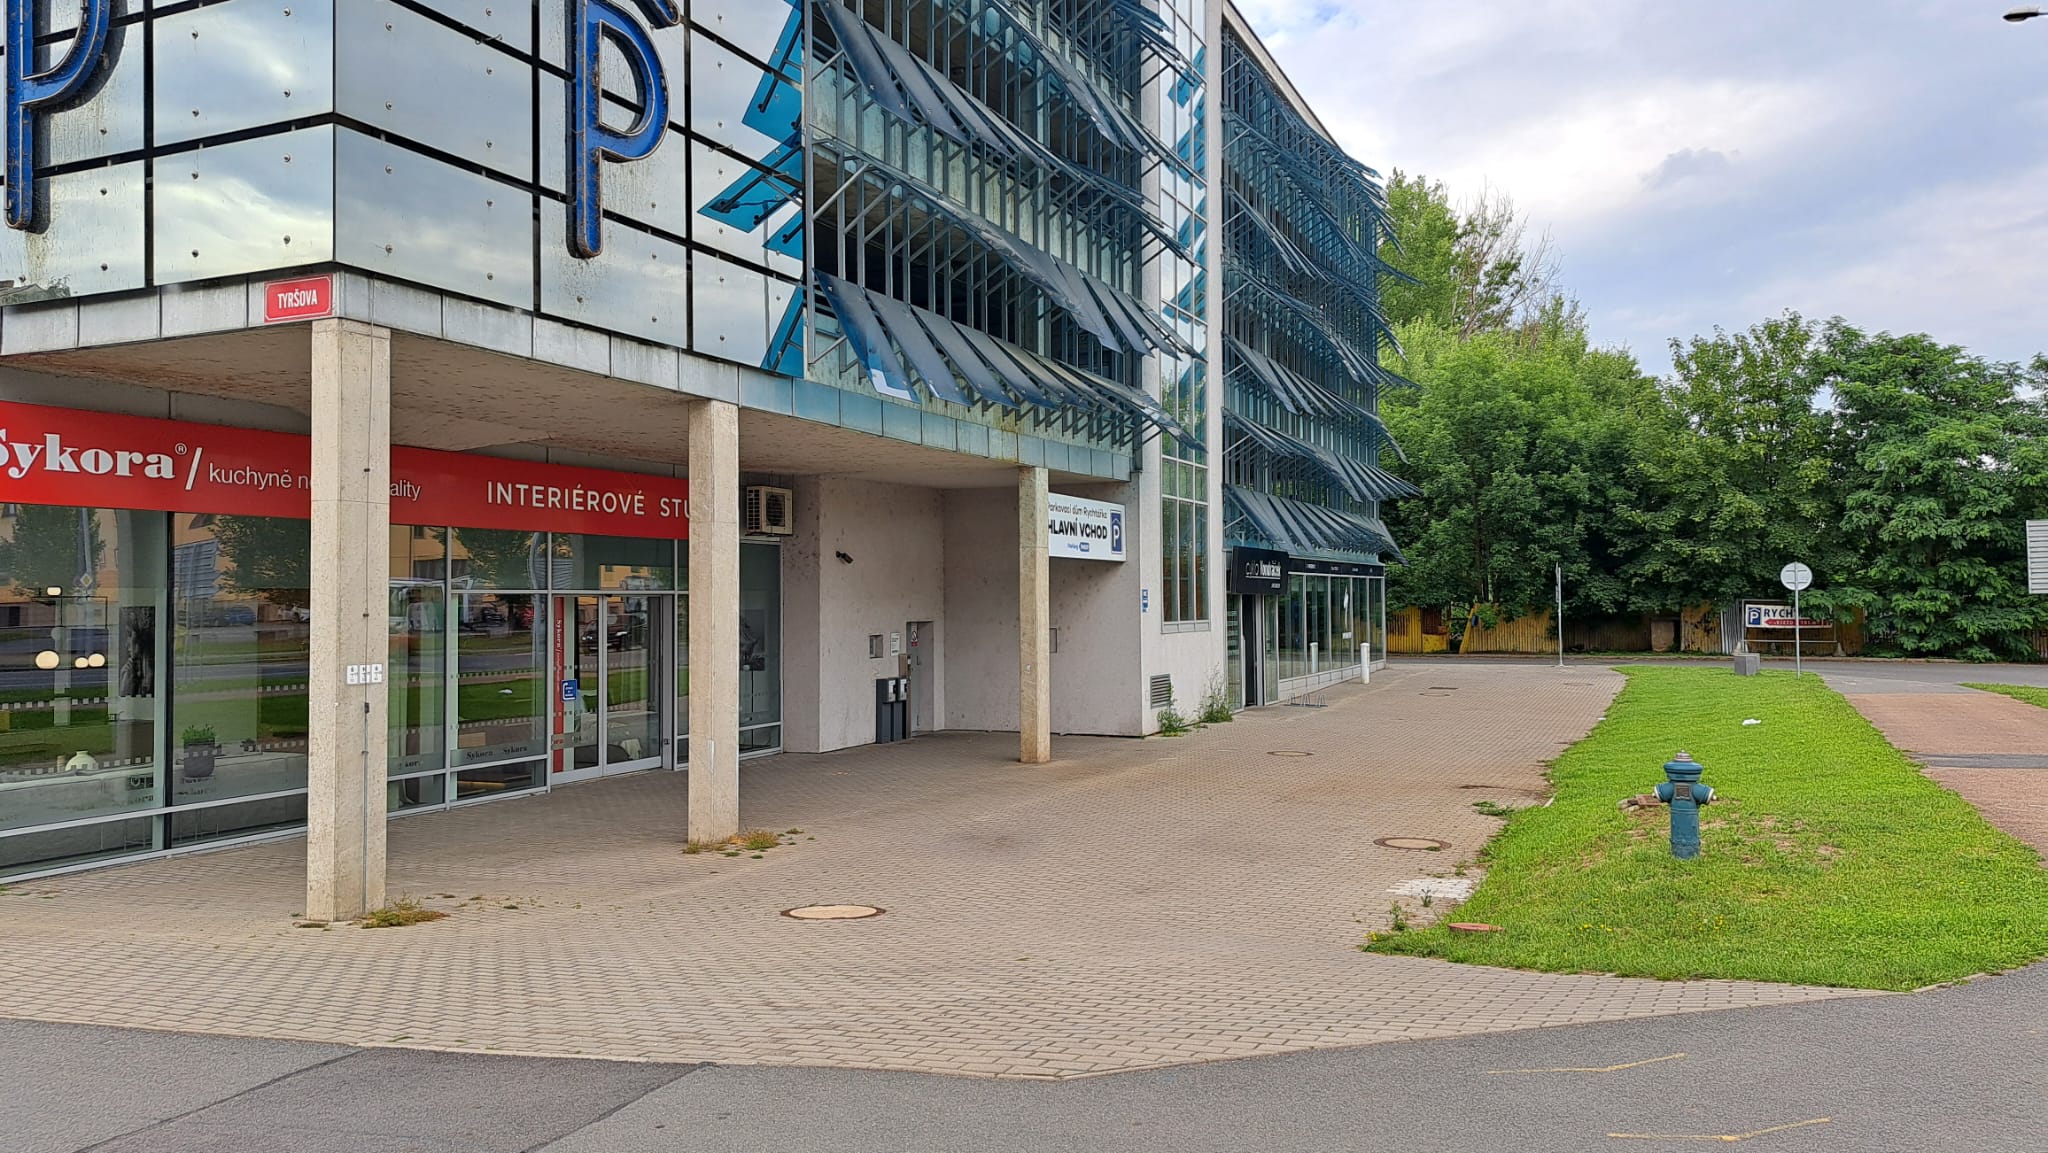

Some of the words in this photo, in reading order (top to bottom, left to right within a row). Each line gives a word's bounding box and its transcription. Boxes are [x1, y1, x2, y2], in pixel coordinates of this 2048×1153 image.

[277, 288, 318, 309] TYRŠOVA
[209, 463, 292, 489] kuchyně
[390, 479, 421, 502] ality
[487, 481, 645, 516] INTERIÉROVÉ
[660, 497, 689, 519] STU
[1048, 517, 1078, 536] HLAVNÍ
[1080, 523, 1108, 539] VCHOD
[1763, 608, 1796, 618] RYCH
